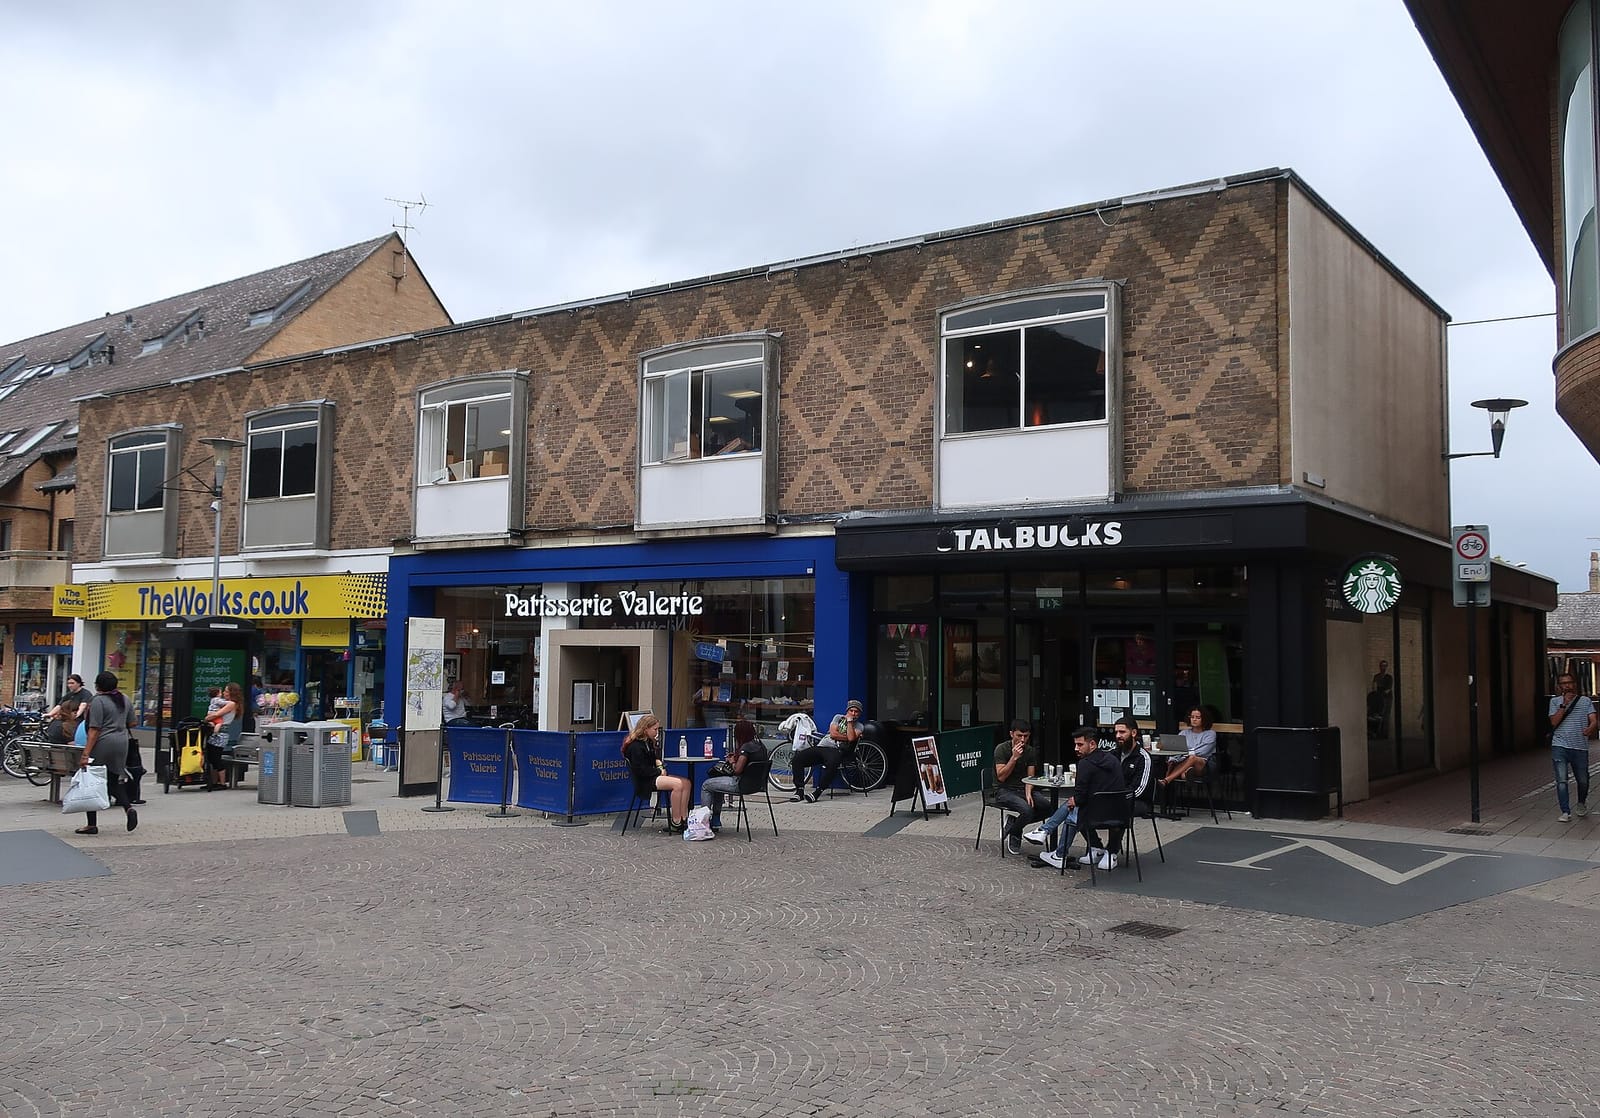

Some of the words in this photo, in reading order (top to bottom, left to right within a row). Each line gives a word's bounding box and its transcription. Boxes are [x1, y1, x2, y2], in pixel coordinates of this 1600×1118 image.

[937, 522, 1123, 552] TARBUCKS
[1463, 567, 1483, 576] End
[65, 589, 80, 598] The
[58, 597, 85, 606] Works
[504, 593, 613, 617] Patisserie
[619, 590, 703, 617] Valerie
[31, 631, 52, 646] Card
[55, 631, 75, 646] Fact
[195, 655, 211, 664] Has
[213, 657, 232, 665] your
[195, 665, 231, 675] eyesight
[195, 675, 231, 685] changed
[462, 751, 502, 762] Patisserie
[528, 754, 562, 768] Patisserie
[469, 762, 497, 773] Valerie
[592, 759, 628, 769] Patisser
[535, 767, 558, 780] Valerie
[599, 769, 630, 781] Valerie
